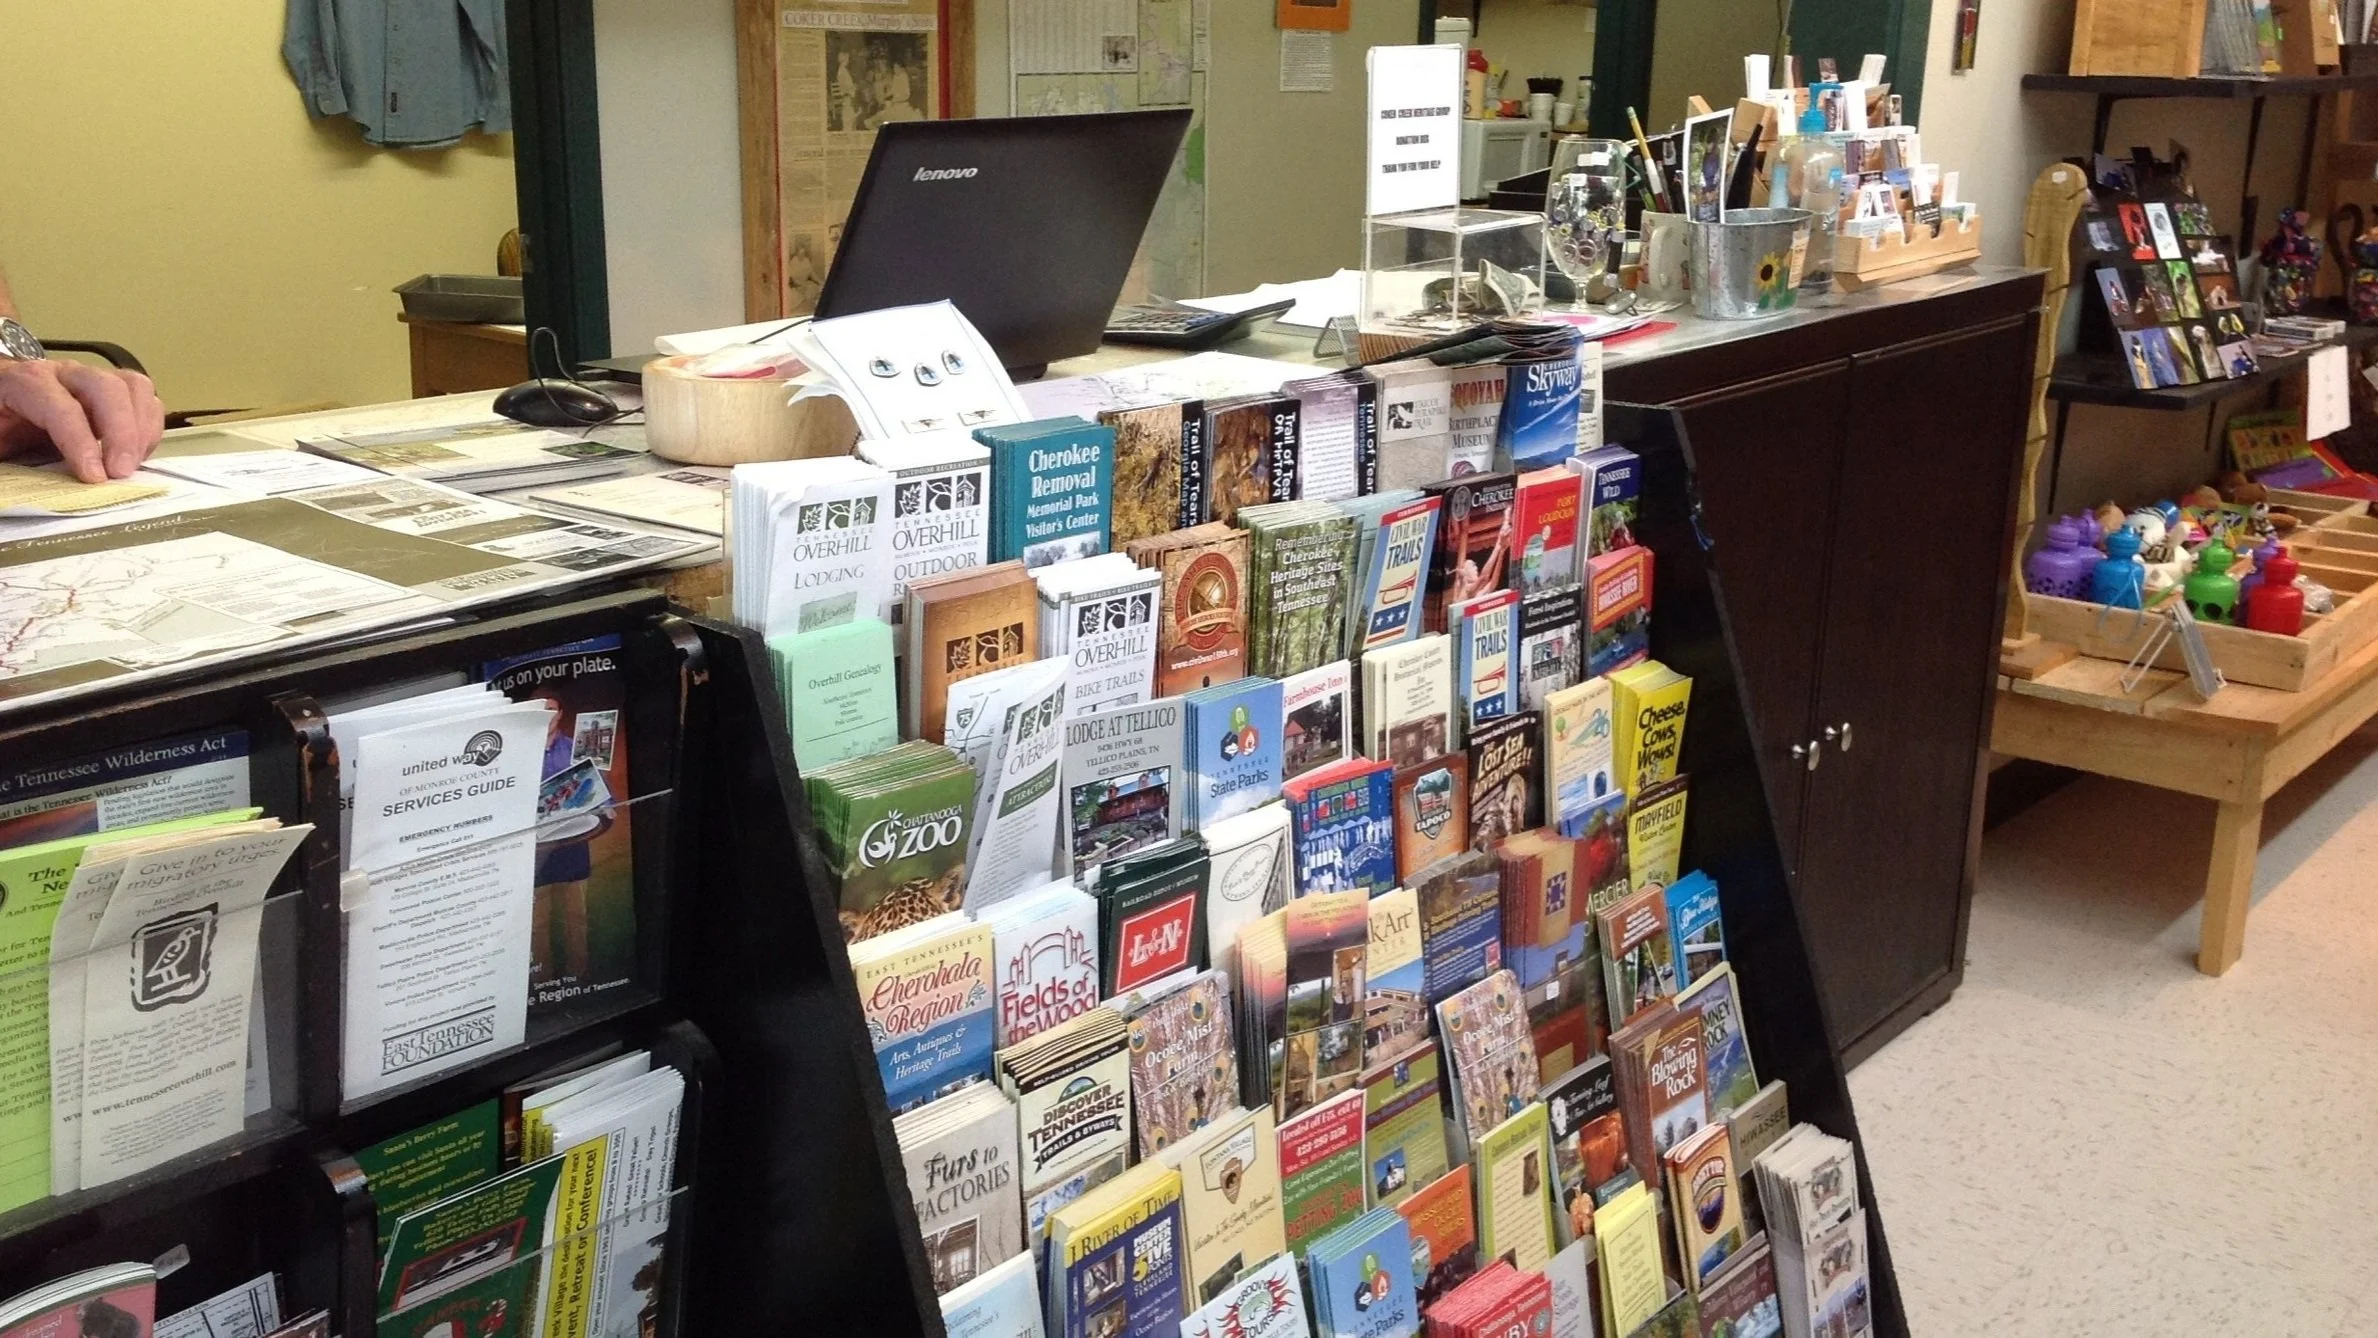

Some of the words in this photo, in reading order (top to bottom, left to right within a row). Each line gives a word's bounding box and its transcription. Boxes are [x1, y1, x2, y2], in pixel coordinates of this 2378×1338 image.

[913, 166, 978, 182] lenovo
[1527, 363, 1578, 396] Skyway
[1189, 418, 1200, 456] Trail
[1284, 412, 1296, 445] Trail
[1029, 444, 1100, 472] Cherokee
[1190, 459, 1200, 477] of
[1284, 448, 1294, 464] of
[1032, 467, 1096, 498] Removal
[1472, 488, 1514, 507] CHEROKEE
[894, 512, 980, 529] TENNESSEE
[1027, 500, 1072, 518] Memorial
[1075, 493, 1099, 508] Park
[1190, 484, 1200, 528] Tears
[892, 520, 980, 550] OVERHILL
[1026, 518, 1063, 539] Visitor's
[1066, 512, 1099, 530] Center
[794, 535, 872, 562] OVERHILL
[1276, 531, 1344, 551] Remembering
[1283, 547, 1333, 565] Cherokee
[1387, 537, 1424, 569] TRAILS
[794, 564, 864, 590] LODGING
[894, 552, 977, 580] OUTDOOR
[1271, 569, 1315, 584] Heritage
[1317, 561, 1343, 573] Sites
[1273, 588, 1284, 600] in
[1285, 576, 1336, 597] Southeast
[1276, 594, 1329, 614] Tennessee
[1077, 628, 1149, 647] TENNESSEE
[1476, 629, 1507, 660] TRAILS
[1075, 638, 1148, 668] OVERHILL
[502, 670, 516, 691] us
[516, 668, 533, 686] on
[535, 662, 570, 683] your
[573, 654, 617, 679] plate.
[809, 673, 842, 689] Overhill
[844, 664, 882, 680] Genealogy
[1075, 681, 1101, 699] BIKE
[1106, 669, 1145, 690] TRAILS
[1284, 682, 1325, 708] Farmhouse
[959, 713, 970, 727] 75
[1067, 719, 1105, 747] LODGE
[1108, 716, 1122, 737] AT
[1126, 707, 1176, 733] TELLICO
[1638, 701, 1685, 730] Cheese
[15, 761, 99, 791] Tennessee
[105, 742, 196, 772] Wilderness
[200, 736, 226, 753] Act
[402, 758, 448, 777] united
[453, 751, 479, 765] way
[1086, 754, 1117, 767] TELLICO
[1478, 745, 1504, 780] LOST
[1504, 732, 1524, 760] SEA
[415, 777, 458, 793] MONROE
[460, 767, 501, 784] COUNTY
[1210, 777, 1236, 798] State
[1238, 769, 1269, 787] Parks
[1471, 747, 1532, 804] ADVENTURE!!
[23, 801, 39, 812] the
[42, 791, 92, 810] Tennessee
[95, 779, 148, 798] Wilderness
[149, 775, 173, 790] Act?
[382, 788, 463, 817] SERVICES
[468, 776, 516, 797] GUIDE
[399, 825, 452, 843] EMERGENCY
[453, 814, 494, 831] NUMBERS
[903, 804, 963, 828] CHATTANOOGA
[1416, 810, 1450, 832] TAPOCO
[1635, 799, 1682, 835] MAYFIELD
[897, 815, 962, 860] ZOO
[139, 856, 185, 876] Give
[190, 852, 208, 866] in
[213, 846, 236, 859] to
[239, 835, 287, 857] your
[28, 867, 66, 884] The
[126, 859, 223, 891] migratory
[867, 964, 896, 979] EAST
[905, 934, 984, 966] TENNESSEE'S
[533, 978, 561, 991] Serving
[562, 975, 578, 985] You
[539, 985, 581, 1004] Region
[592, 976, 630, 992] Tennessee
[866, 952, 982, 1013] Cherohala
[1002, 976, 1069, 1025] Fields
[1072, 970, 1090, 996] of
[886, 991, 964, 1036] Region
[1008, 1020, 1036, 1046] the
[1035, 986, 1097, 1032] Wood
[1494, 1010, 1515, 1026] Mist
[383, 1023, 494, 1070] FOUNDATION
[384, 1038, 415, 1056] East
[420, 1014, 494, 1045] Tennessee
[914, 1033, 954, 1054] Antiques
[1145, 1038, 1183, 1069] Ocoee
[1186, 1021, 1213, 1043] Mist
[896, 1058, 935, 1080] Heritage
[937, 1043, 963, 1062] Trails
[1166, 1051, 1199, 1076] Farm
[1651, 1044, 1698, 1087] Blowing
[1663, 1044, 1677, 1058] The
[1666, 1070, 1697, 1099] Rock
[1043, 1084, 1112, 1126] DISCOVER
[1028, 1091, 1125, 1150] TENNESSEE
[1041, 1136, 1074, 1161] TRAILS
[1082, 1119, 1116, 1137] BYWAYS
[924, 1149, 979, 1192] Furs
[983, 1146, 999, 1163] to
[577, 1149, 597, 1231] Conference!
[915, 1161, 1011, 1223] FACTORIES
[1081, 1224, 1120, 1256] RIVER
[1124, 1212, 1139, 1230] OF
[1143, 1190, 1172, 1216] TIME
[578, 1235, 588, 1249] or
[571, 1251, 587, 1304] Retreat
[1374, 1307, 1405, 1335] Parks
